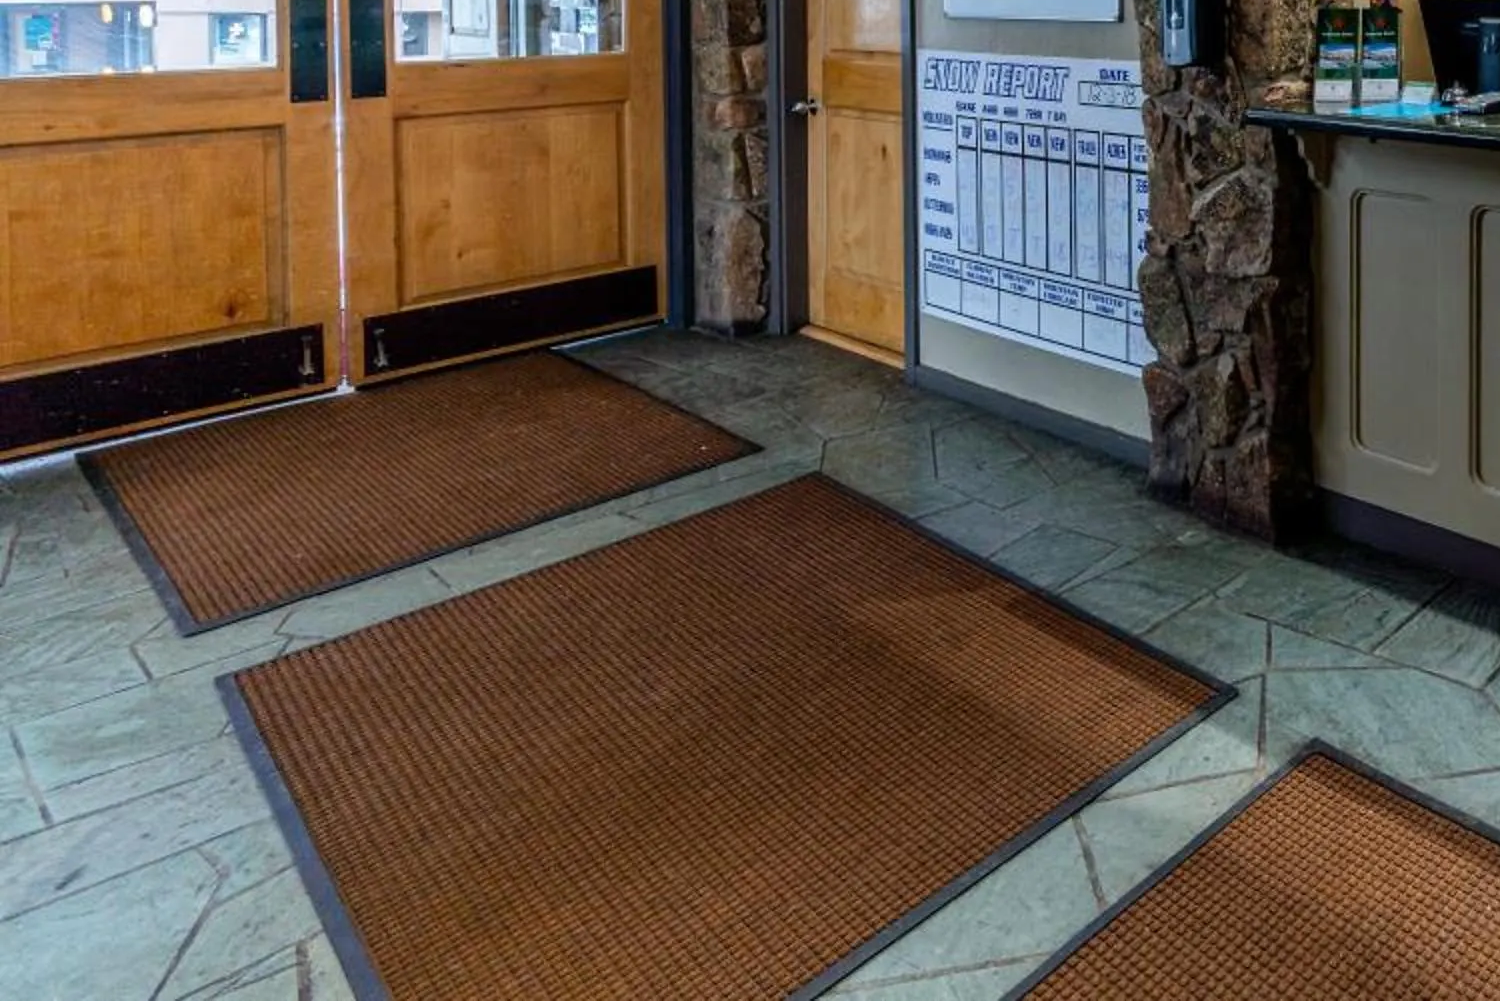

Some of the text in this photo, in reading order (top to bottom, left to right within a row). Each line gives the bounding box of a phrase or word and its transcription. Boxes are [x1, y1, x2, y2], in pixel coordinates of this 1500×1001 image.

[923, 57, 1071, 103] SNOW REPORT
[1099, 68, 1130, 82] DATE
